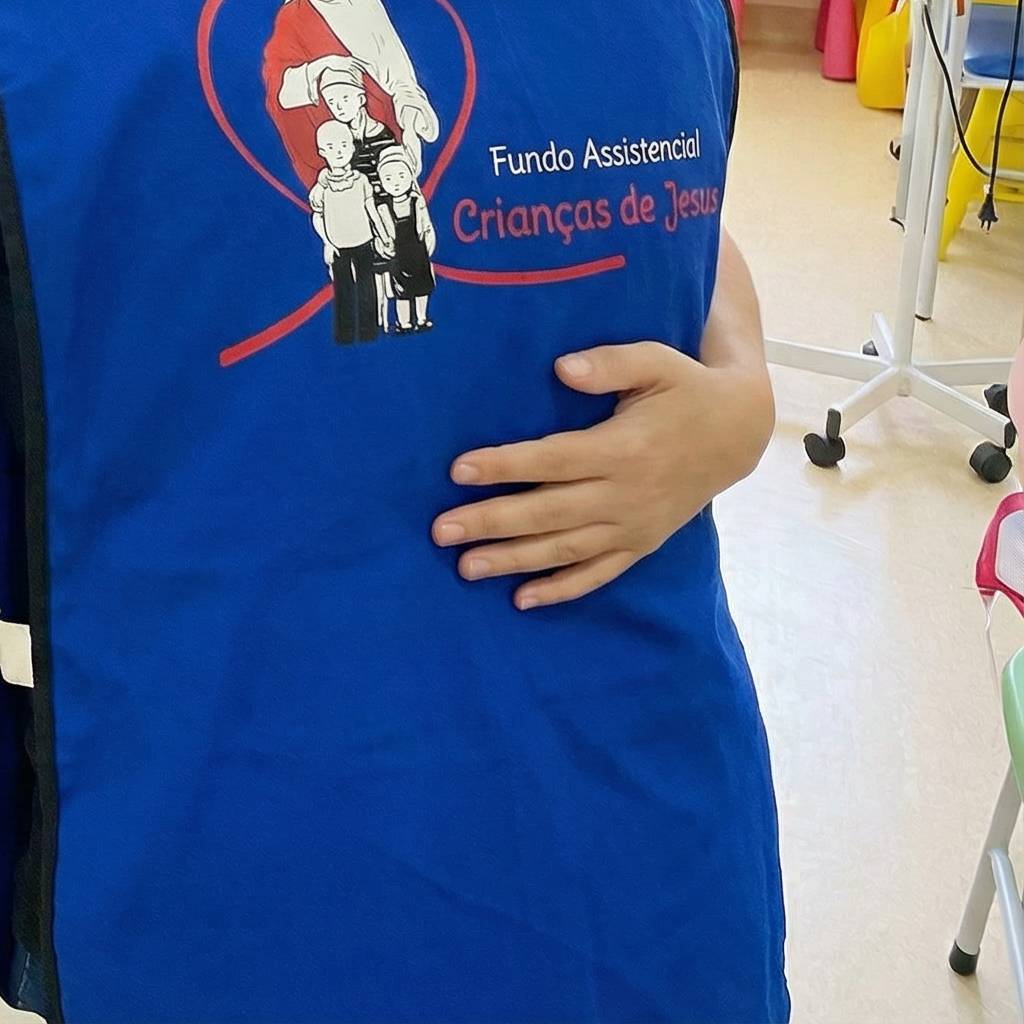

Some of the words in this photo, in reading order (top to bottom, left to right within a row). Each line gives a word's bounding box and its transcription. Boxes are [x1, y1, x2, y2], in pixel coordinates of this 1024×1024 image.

[489, 141, 574, 176] Fundo
[583, 128, 700, 169] Assistencial
[453, 196, 612, 245] Crianças
[620, 182, 655, 226] de
[664, 180, 719, 232] Jesus
